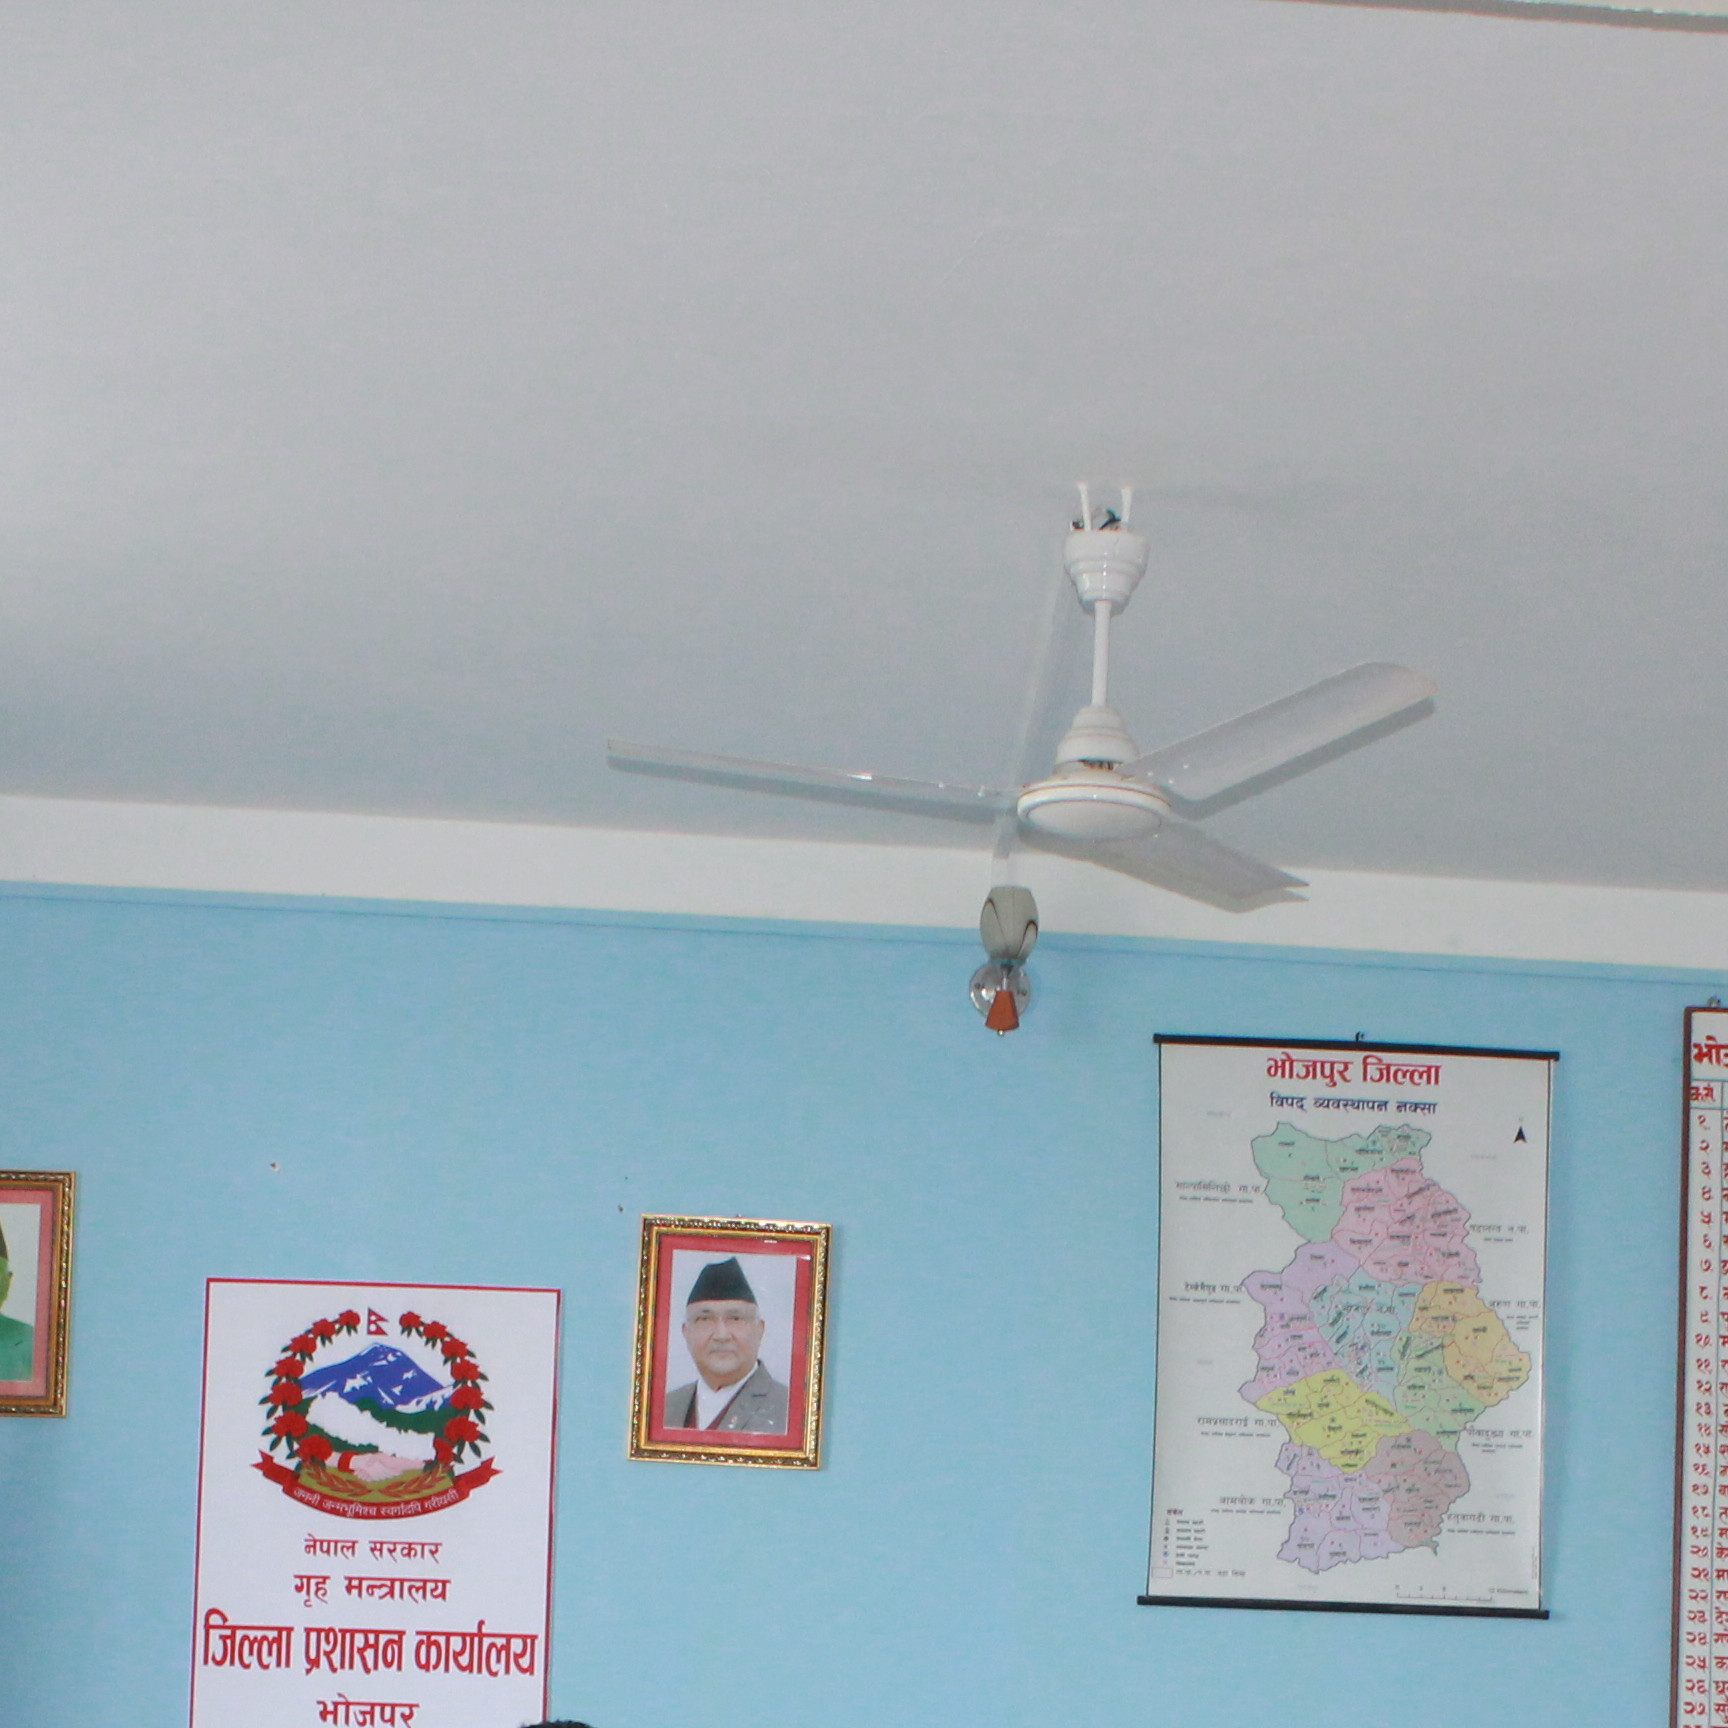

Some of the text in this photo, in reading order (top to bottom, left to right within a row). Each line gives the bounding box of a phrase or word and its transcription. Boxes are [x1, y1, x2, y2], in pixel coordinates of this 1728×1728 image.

[1267, 1051, 1442, 1087] भोजपुर जिल्ला
[1313, 1097, 1389, 1112] व्यवस्थापन
[1396, 1100, 1438, 1115] नक्सा
[304, 1532, 443, 1565] नेपाल सरकार
[293, 1574, 452, 1608] गृह मन्त्रालय
[202, 1607, 539, 1679] जिल्ला प्रशासन कार्यालय
